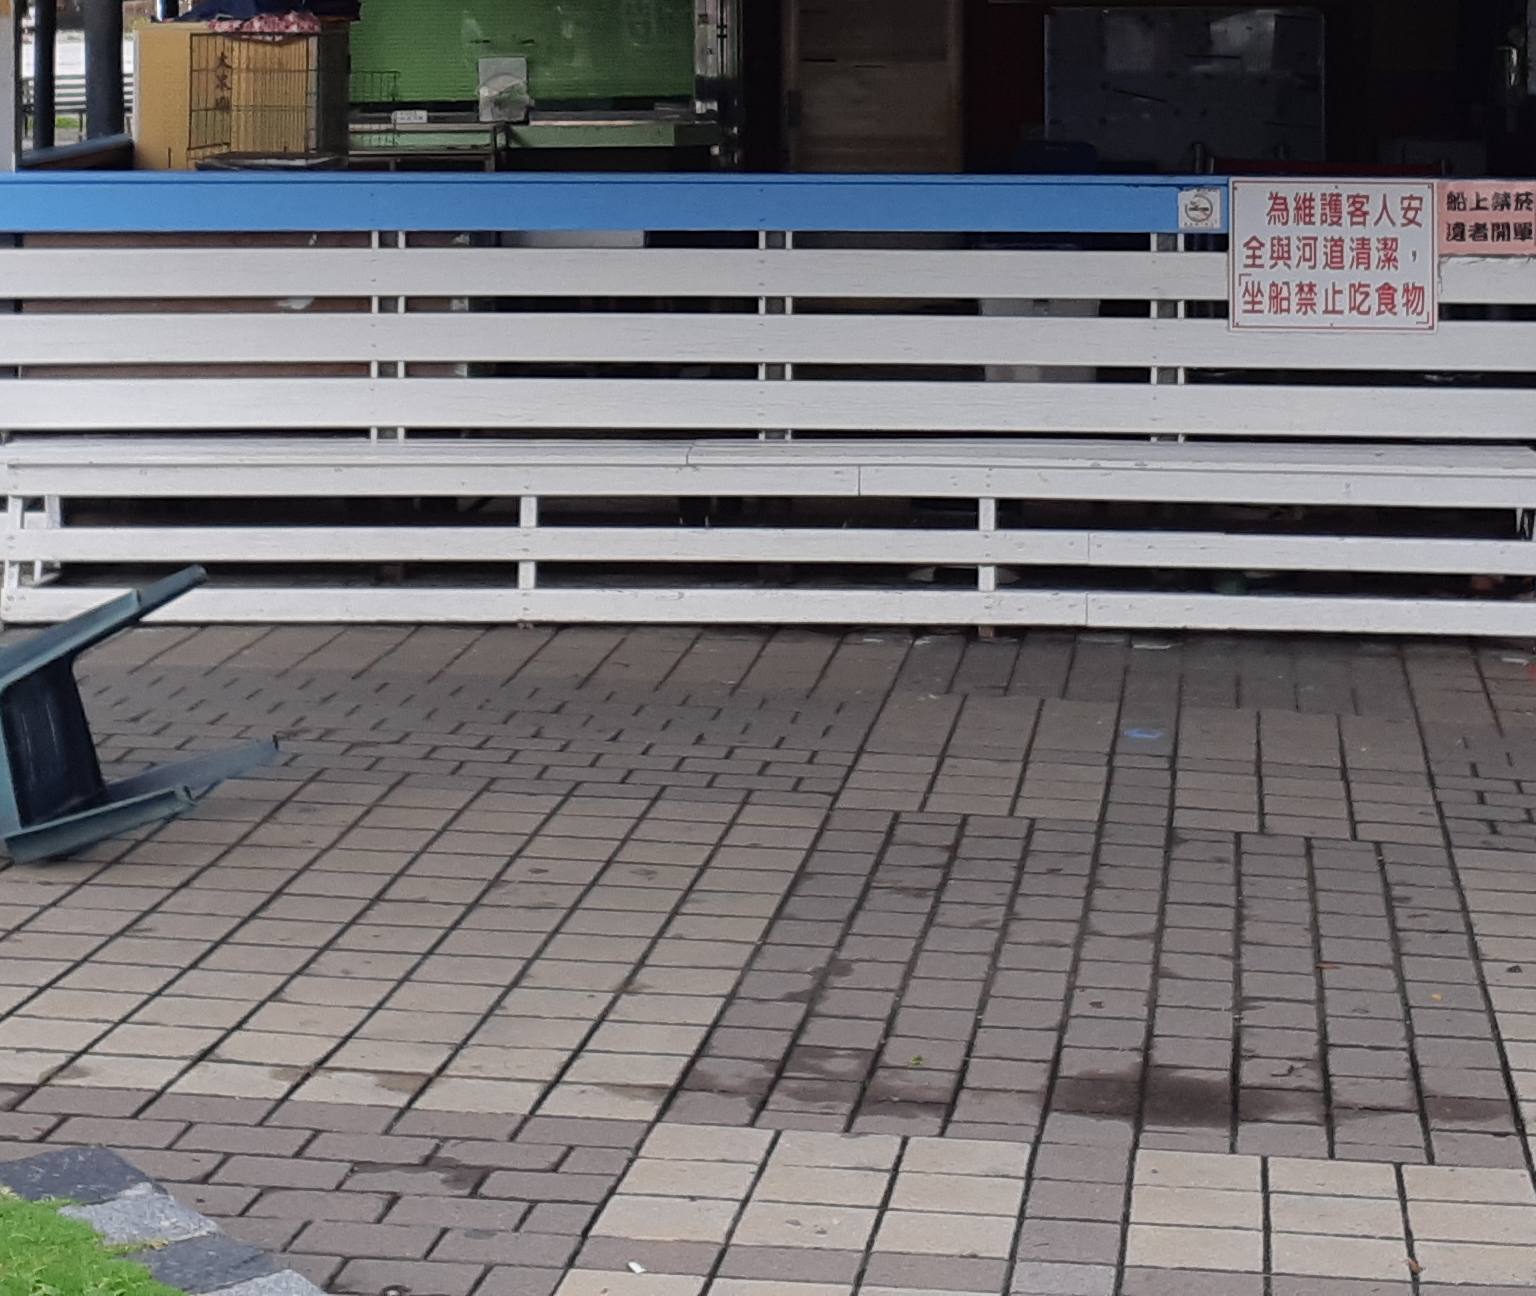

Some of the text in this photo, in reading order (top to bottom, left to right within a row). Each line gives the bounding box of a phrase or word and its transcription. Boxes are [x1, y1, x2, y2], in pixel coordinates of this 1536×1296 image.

[1266, 190, 1425, 229] 為維護客人安
[1242, 235, 1417, 271] 全與河道清潔，
